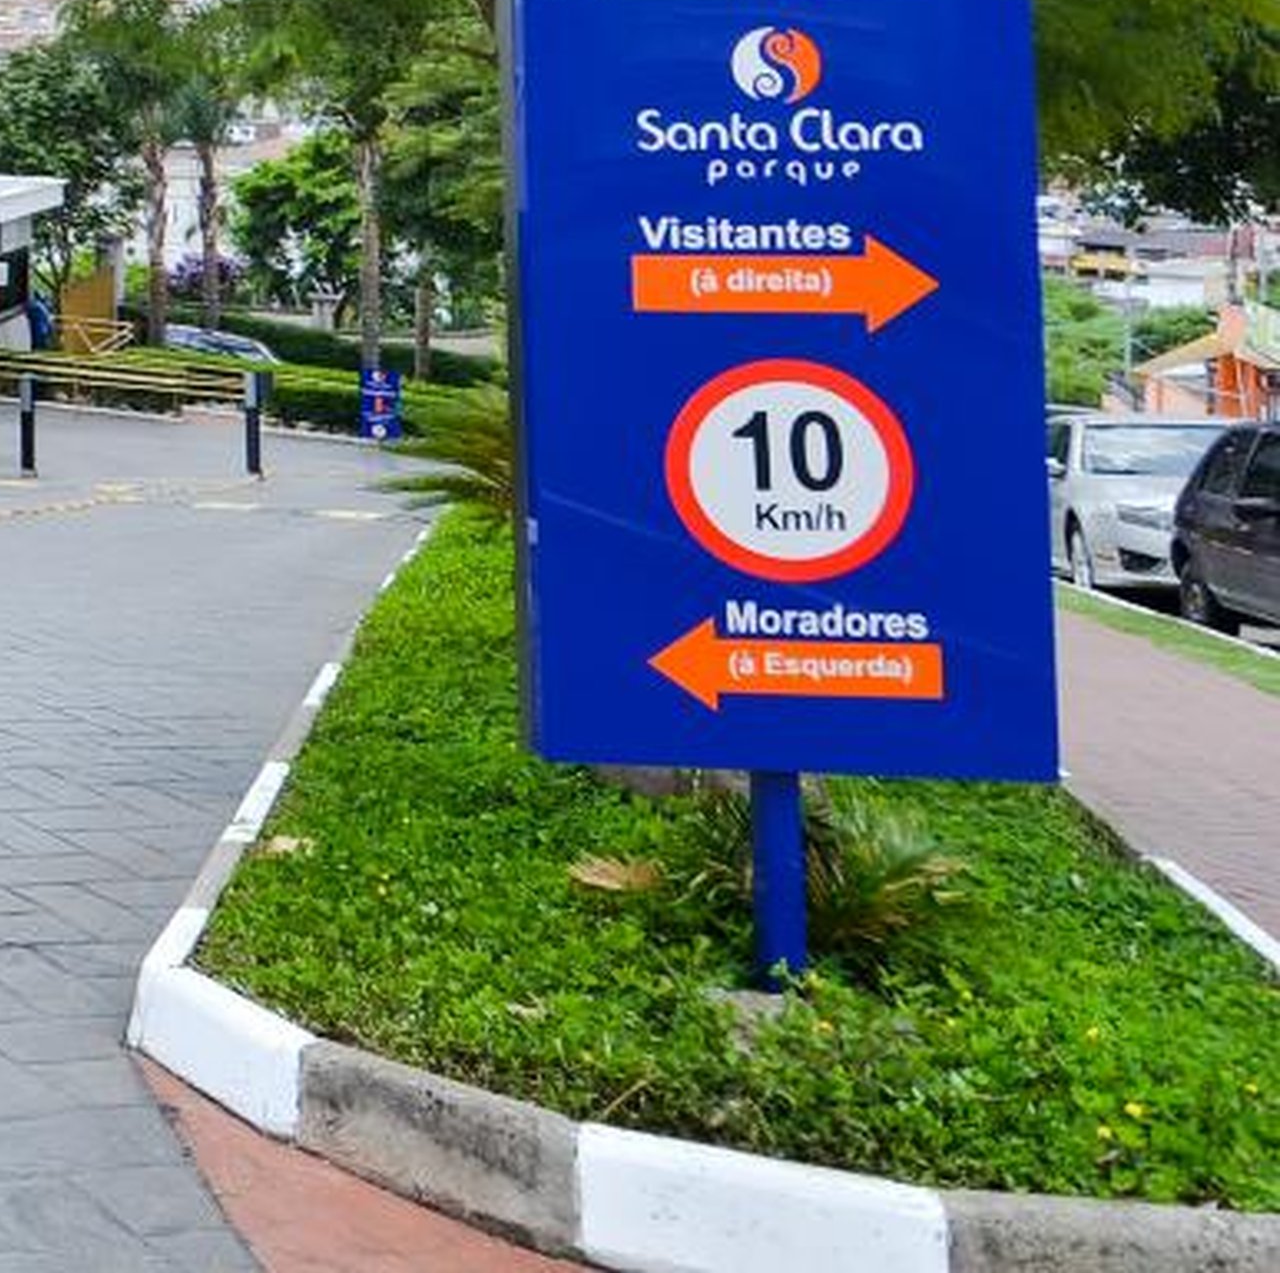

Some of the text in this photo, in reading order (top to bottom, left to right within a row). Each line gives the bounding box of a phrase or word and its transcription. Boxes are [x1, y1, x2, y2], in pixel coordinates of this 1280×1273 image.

[637, 107, 924, 152] Santa Clara
[707, 159, 861, 186] parque
[639, 216, 852, 250] Visitantes
[727, 268, 833, 297] direita)
[732, 410, 844, 492] 10
[755, 503, 847, 532] Km/h
[725, 600, 930, 640] Moradores
[764, 651, 914, 685] Esquerda)
